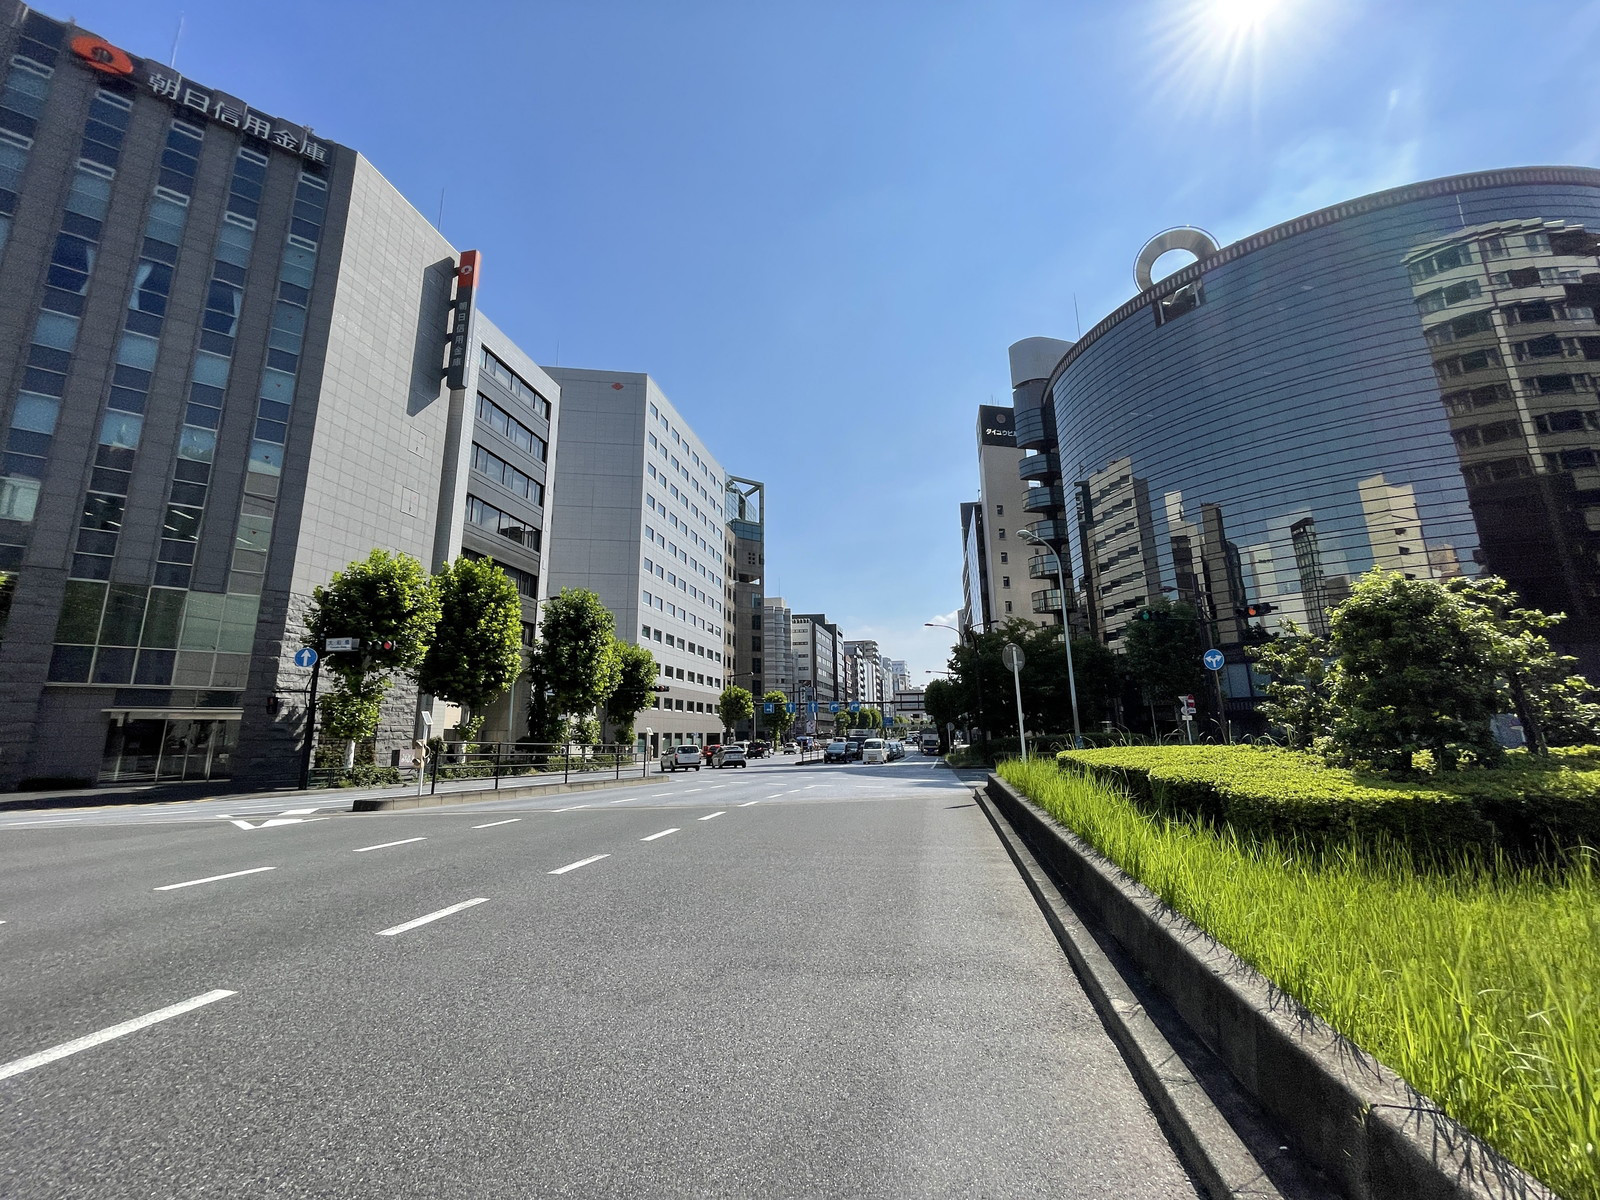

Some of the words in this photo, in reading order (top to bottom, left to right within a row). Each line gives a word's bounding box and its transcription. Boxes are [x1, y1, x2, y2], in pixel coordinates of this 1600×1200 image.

[147, 73, 328, 163] 朝日信用金庫
